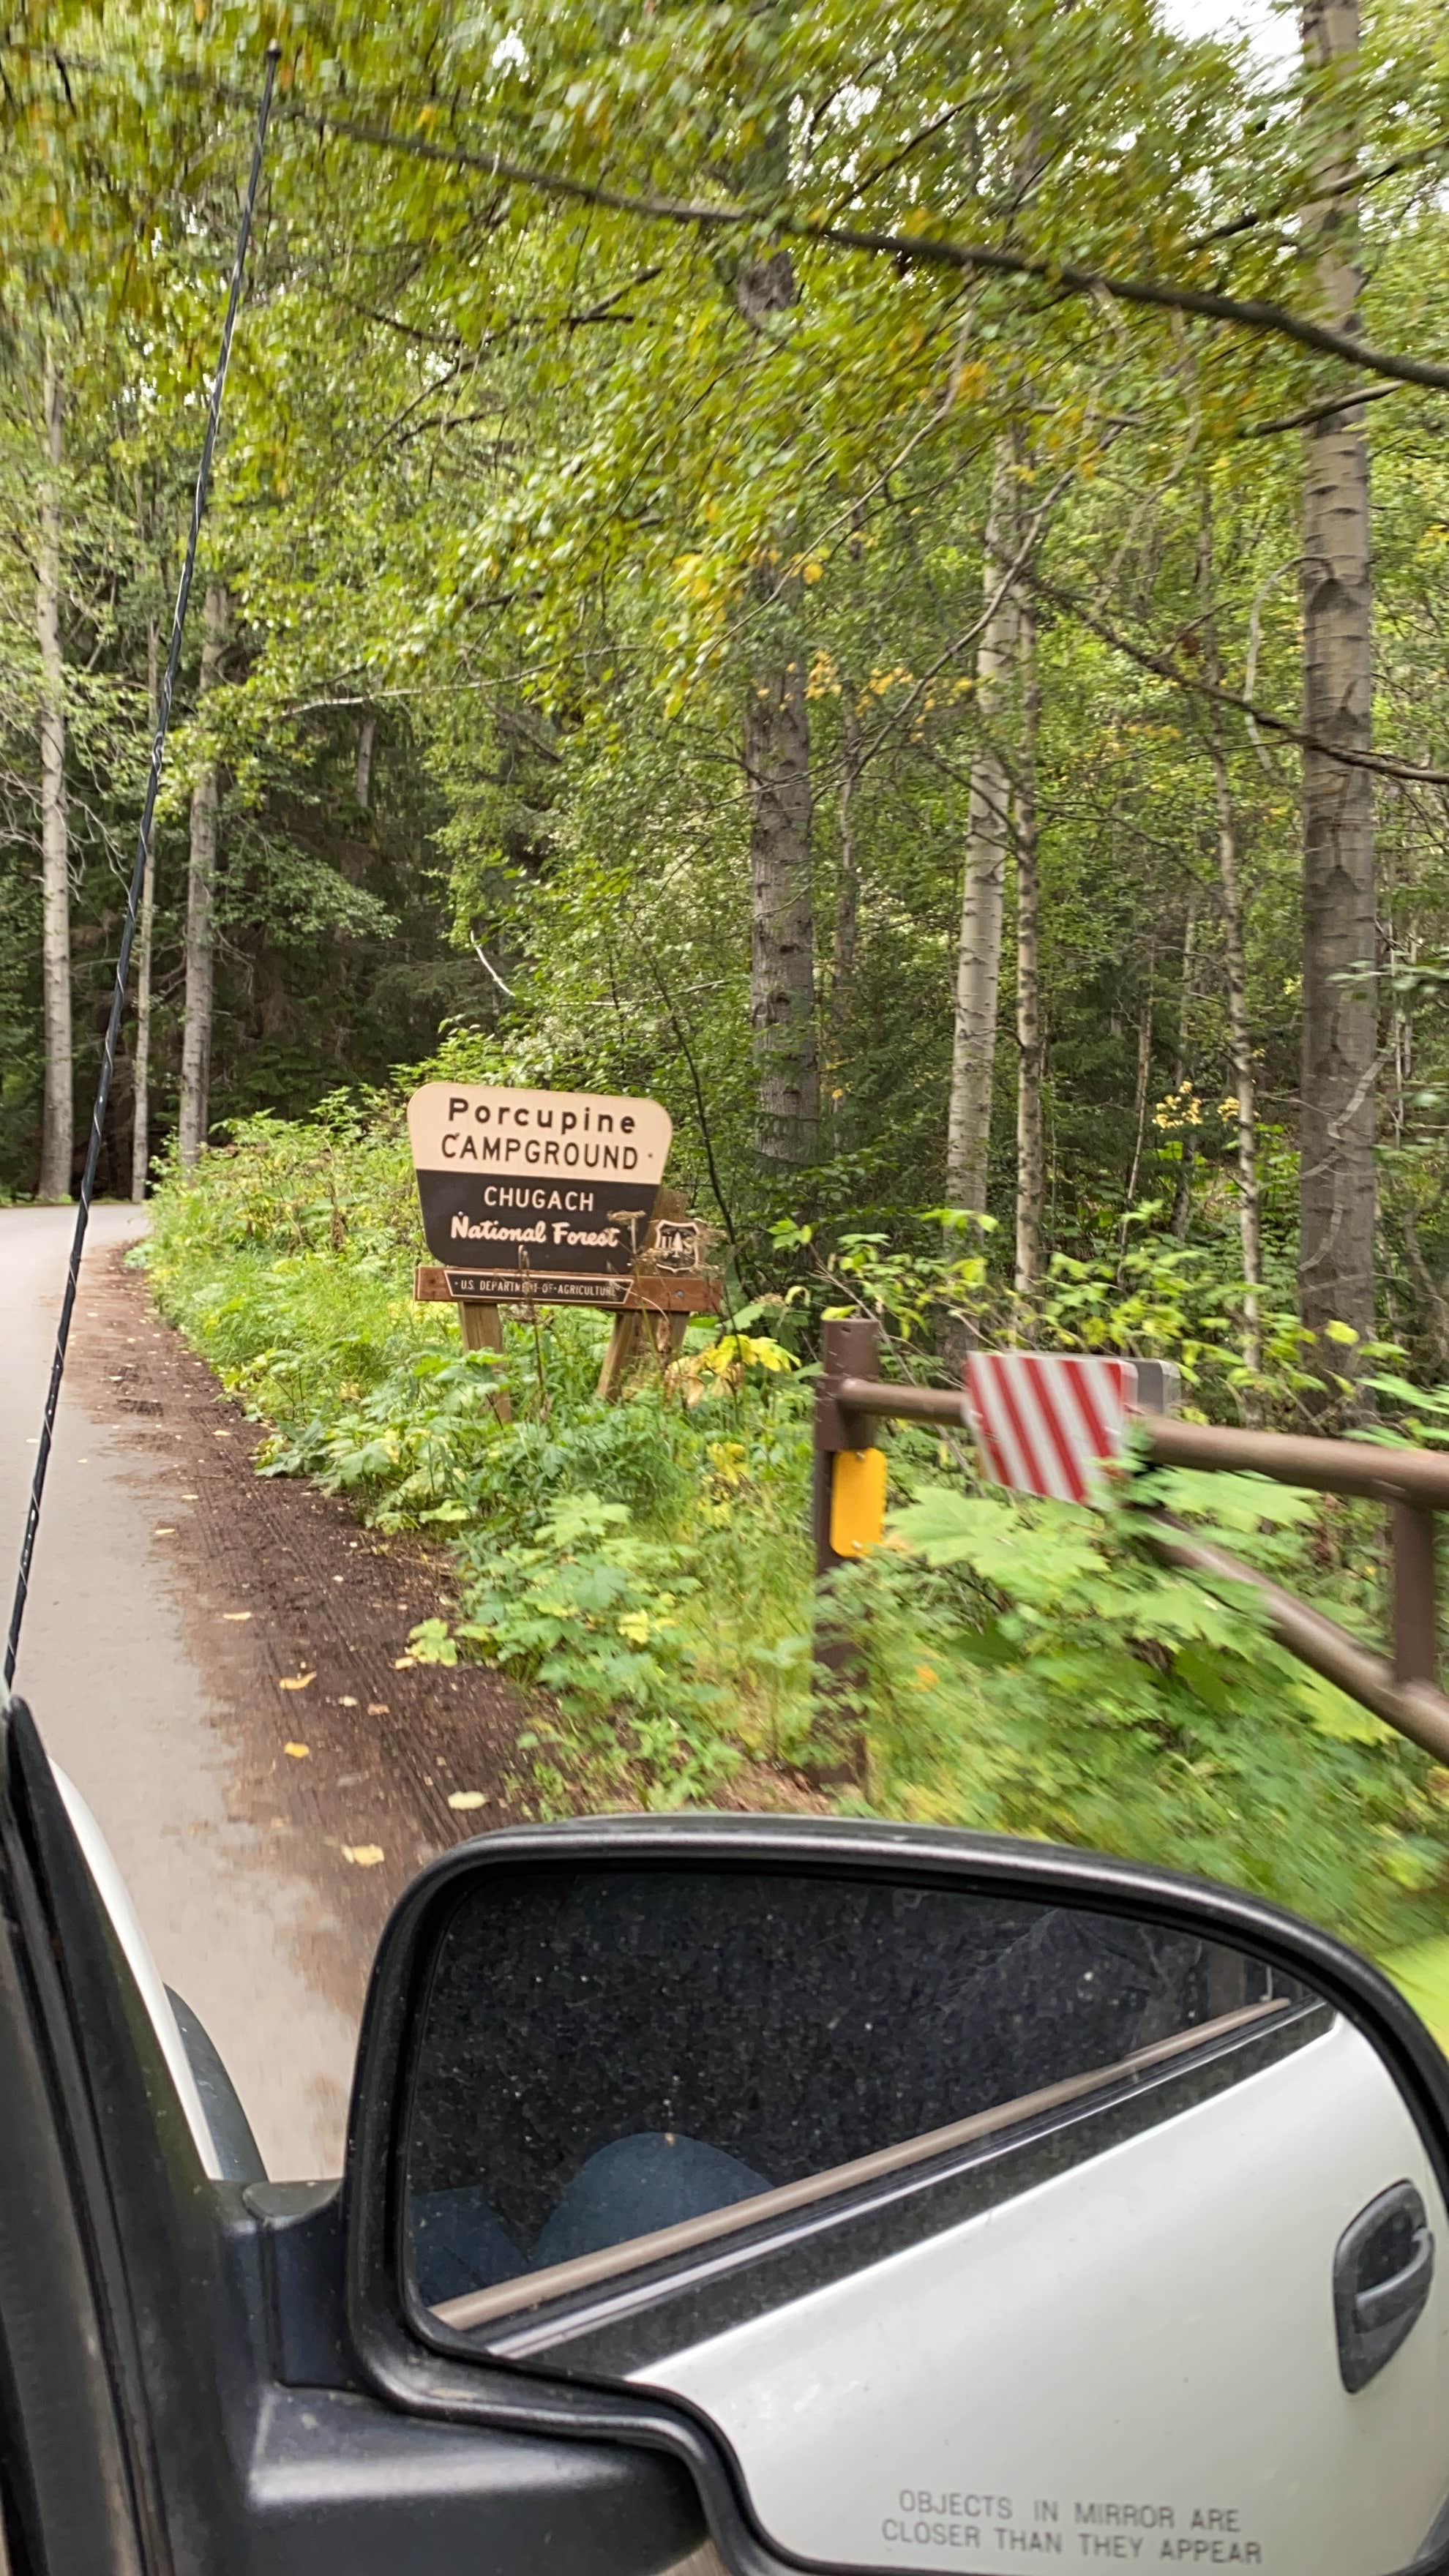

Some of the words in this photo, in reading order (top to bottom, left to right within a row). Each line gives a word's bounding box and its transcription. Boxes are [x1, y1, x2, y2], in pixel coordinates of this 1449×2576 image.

[448, 1097, 636, 1134] Porcupine
[441, 1134, 638, 1170] CAMPGROUND
[484, 1186, 594, 1212] CHUGACH
[451, 1215, 547, 1243] National
[551, 1221, 621, 1247] Forest
[898, 2489, 1013, 2520] OBJECTS
[1034, 2500, 1058, 2523] IN
[1074, 2501, 1175, 2530] MIRROR
[1190, 2508, 1241, 2533] ARE
[881, 2519, 981, 2548] CLOSER
[994, 2527, 1063, 2555] THAN
[1078, 2533, 1144, 2559] THEY
[1159, 2539, 1262, 2564] APPEAR
